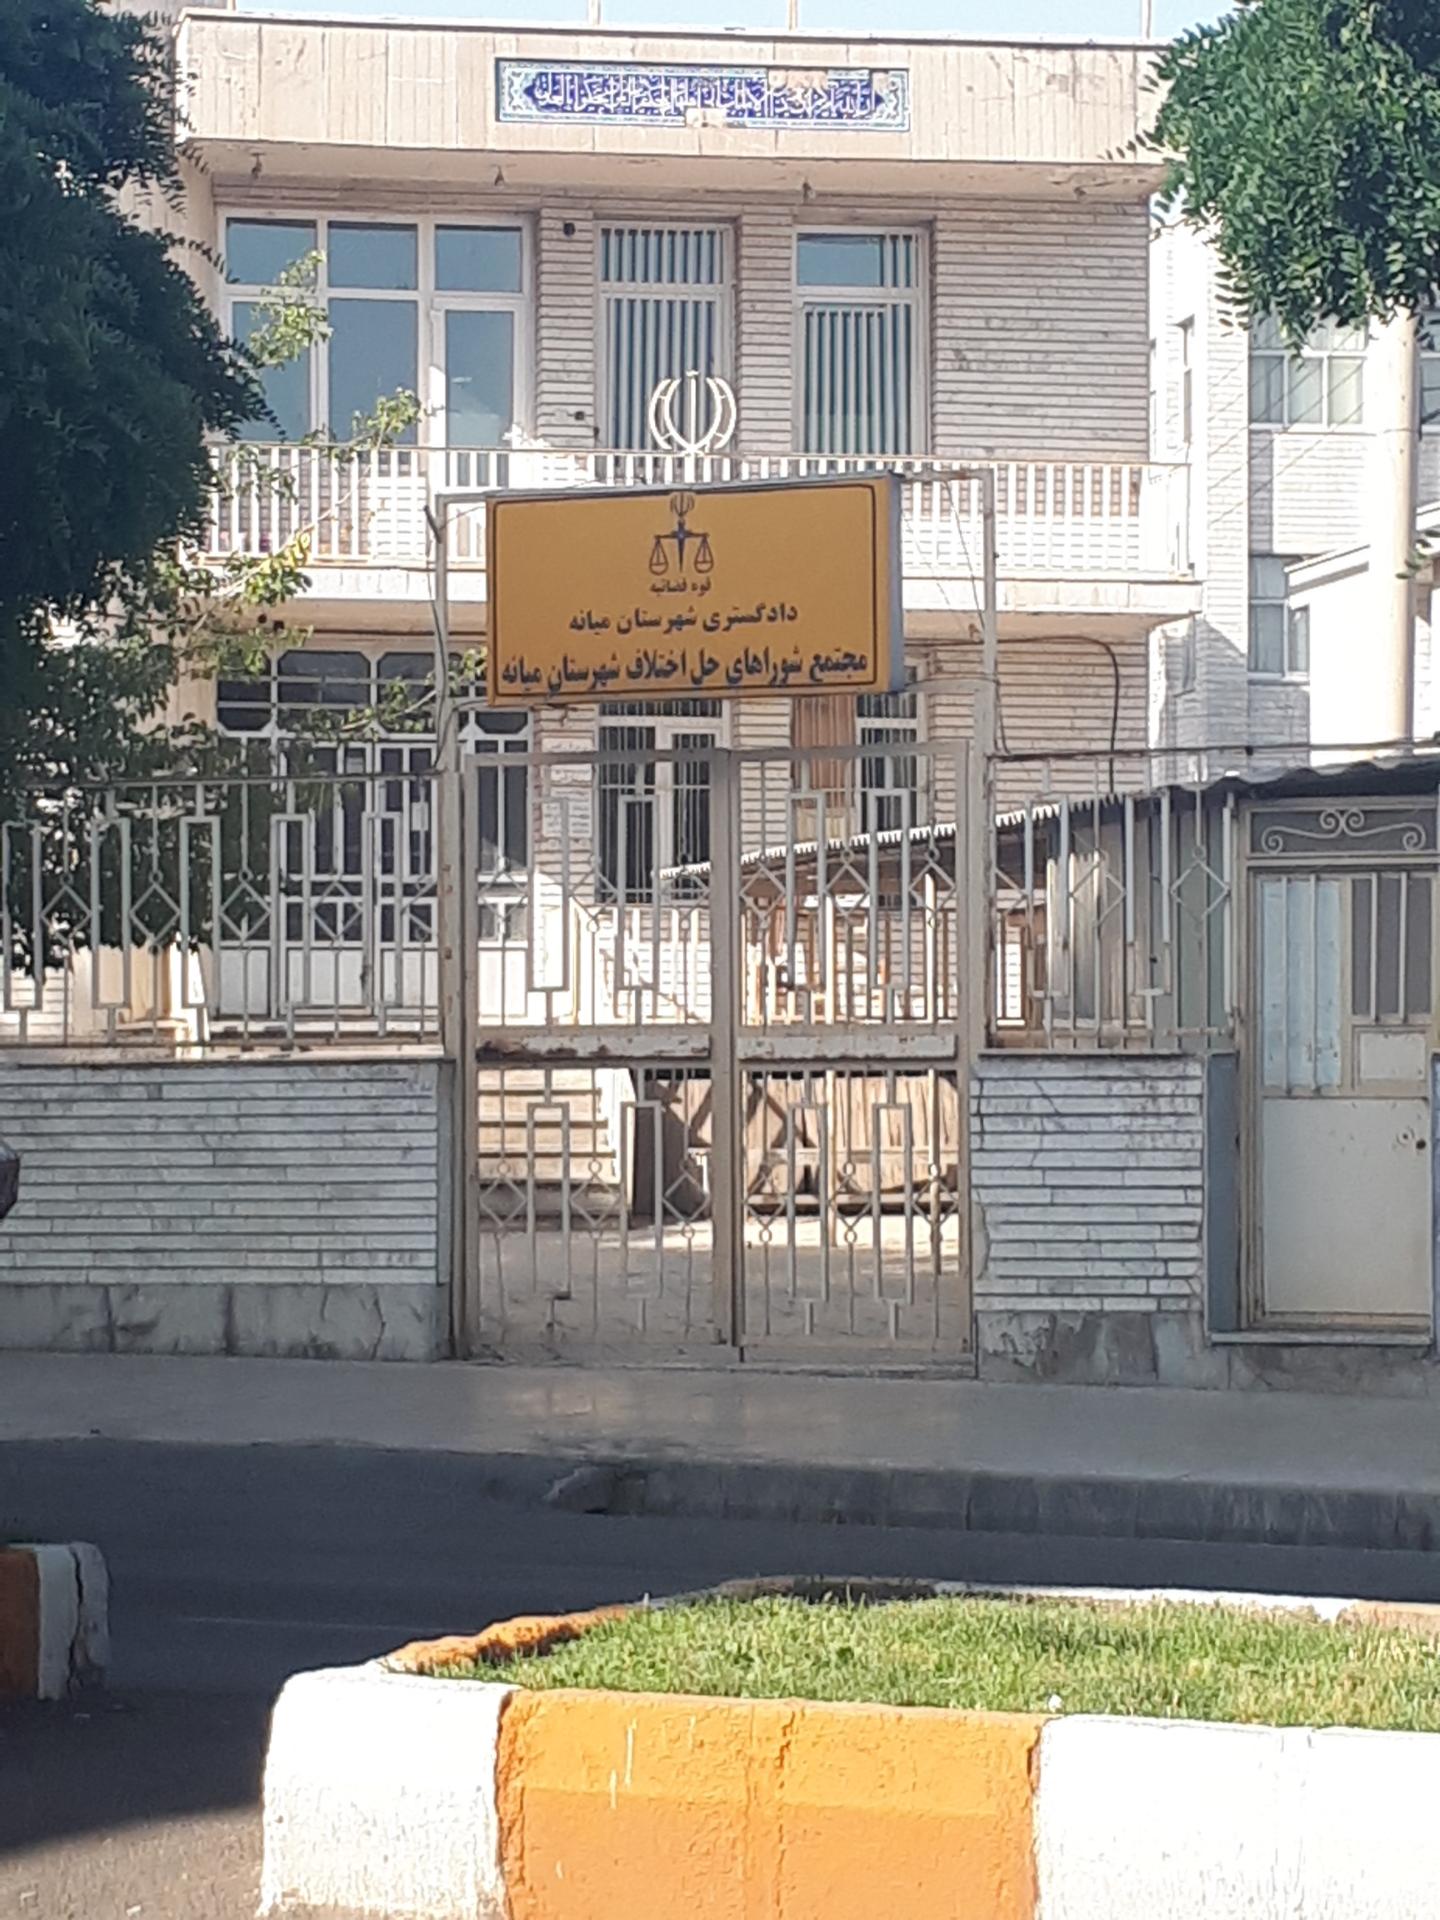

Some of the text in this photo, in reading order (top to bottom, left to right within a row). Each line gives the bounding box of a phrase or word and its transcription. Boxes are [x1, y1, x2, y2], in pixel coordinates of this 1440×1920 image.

[569, 602, 799, 636] دادگستری شهرستان میانه
[502, 645, 868, 692] مجتمع شوراهای حل اختلاف شهرستان میانه
